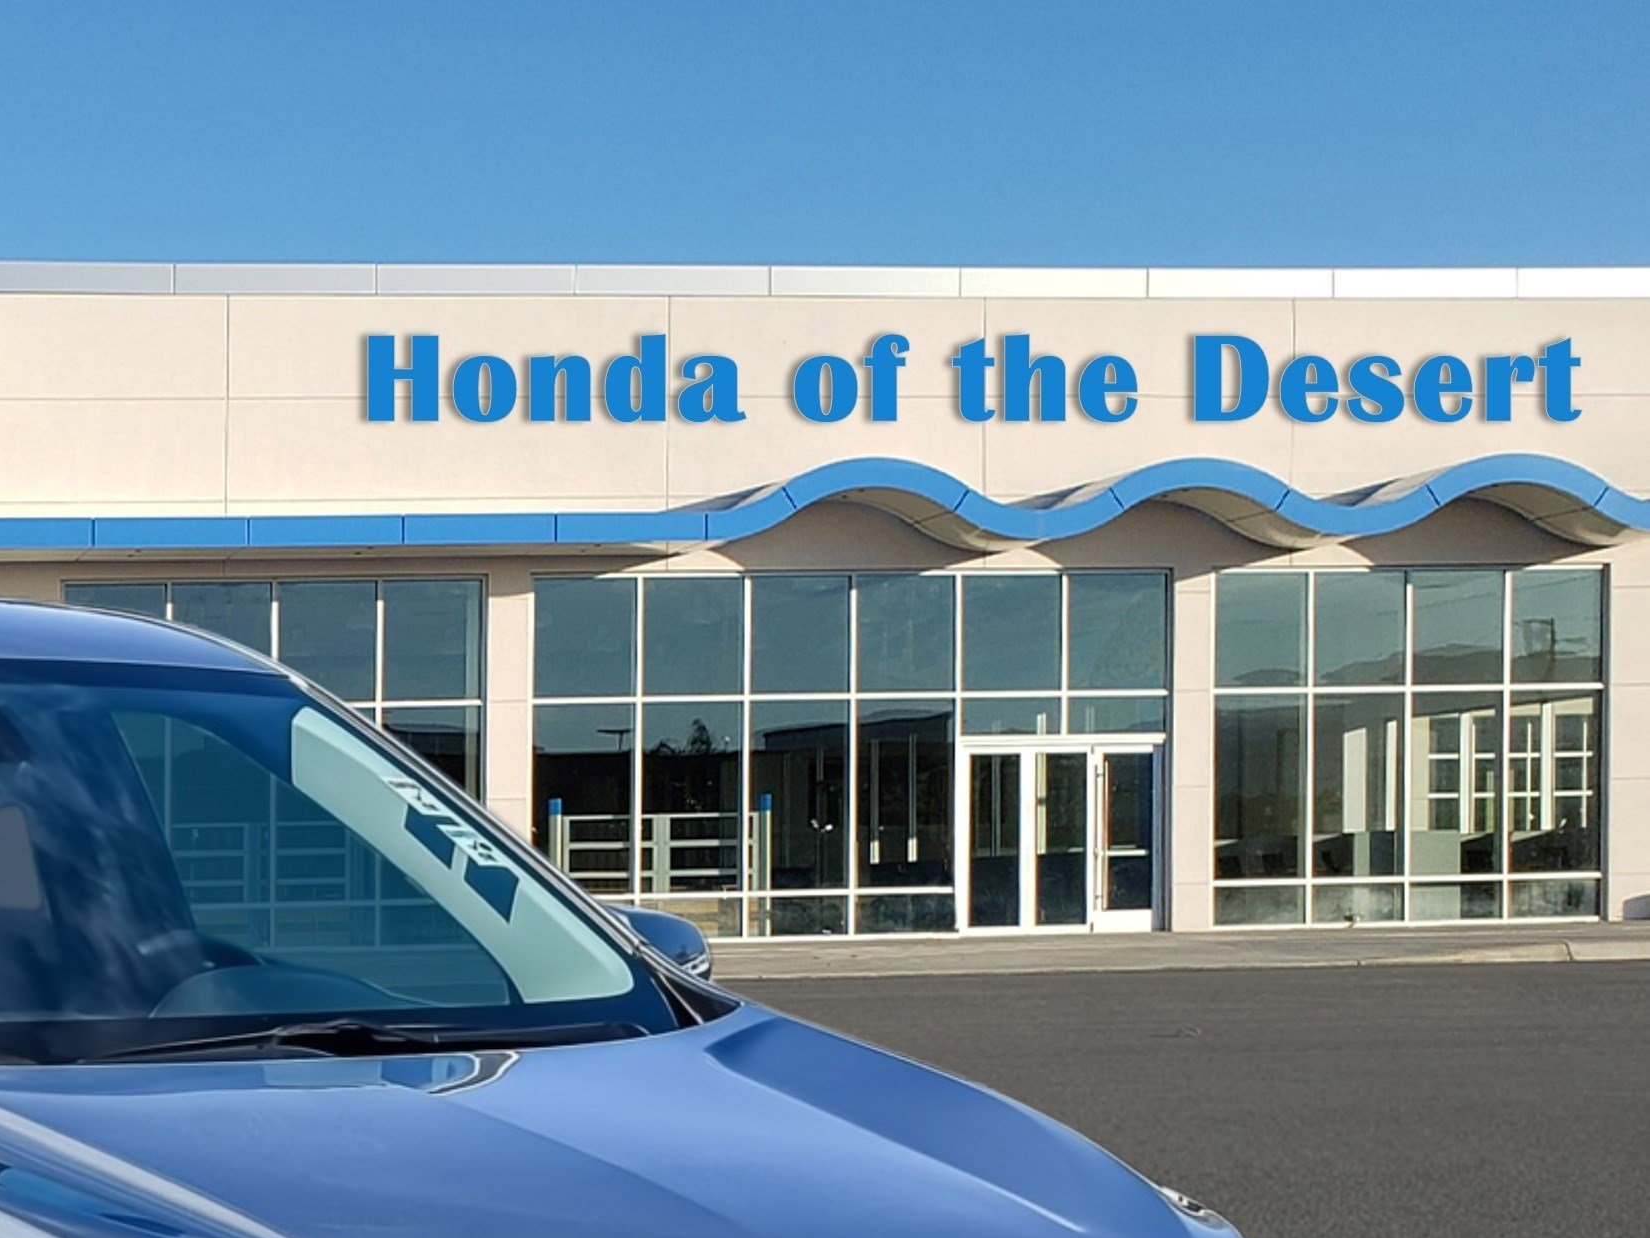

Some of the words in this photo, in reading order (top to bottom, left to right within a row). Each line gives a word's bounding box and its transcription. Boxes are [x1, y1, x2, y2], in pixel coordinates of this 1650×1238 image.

[364, 332, 747, 424] Honda
[792, 333, 911, 424] of
[951, 332, 1139, 424] the
[1191, 334, 1583, 424] Desert
